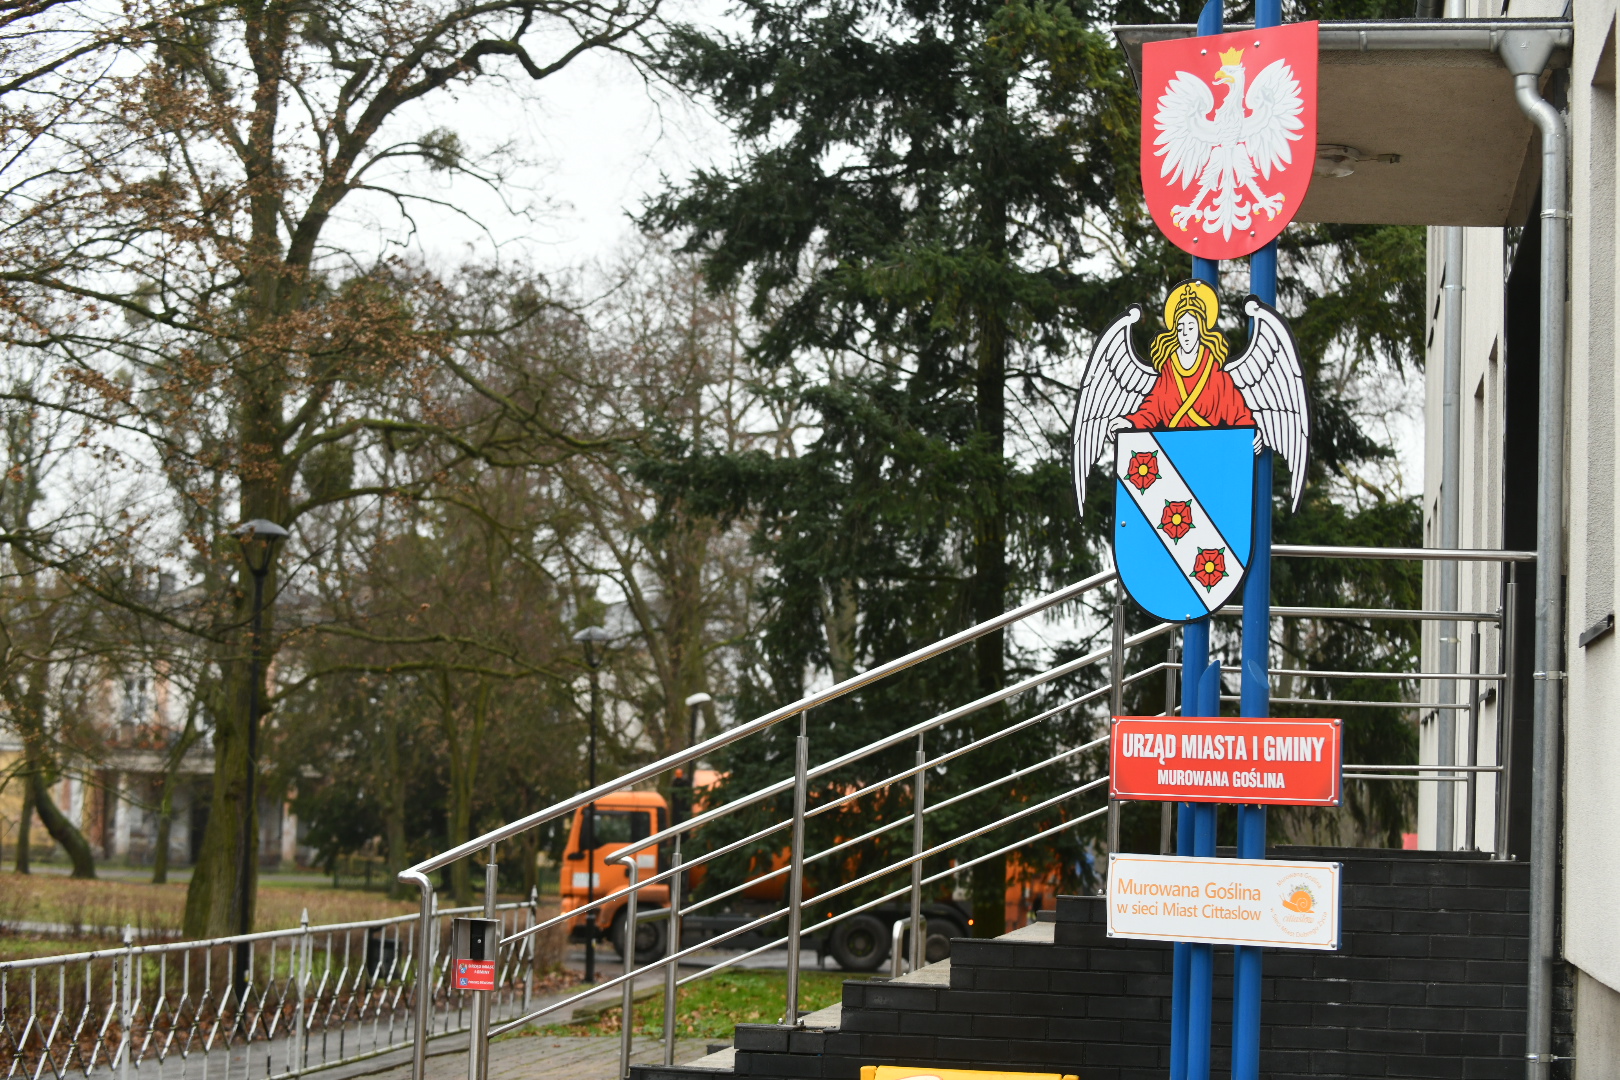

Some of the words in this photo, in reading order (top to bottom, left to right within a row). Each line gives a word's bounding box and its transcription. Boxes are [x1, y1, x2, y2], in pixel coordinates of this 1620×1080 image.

[1122, 733, 1176, 765] URZĄD
[1181, 735, 1247, 760] MIASTA
[1252, 736, 1258, 760] I
[1263, 736, 1325, 762] GMINY
[1157, 769, 1229, 787] MUROWANA
[1232, 768, 1285, 789] GOŚLINA
[1117, 878, 1199, 898] Murowana
[1204, 882, 1261, 901] Goślina
[1117, 904, 1128, 914] w
[1131, 901, 1158, 916] sieci
[1162, 903, 1198, 918] Miast
[1202, 904, 1262, 921] Cittaslow
